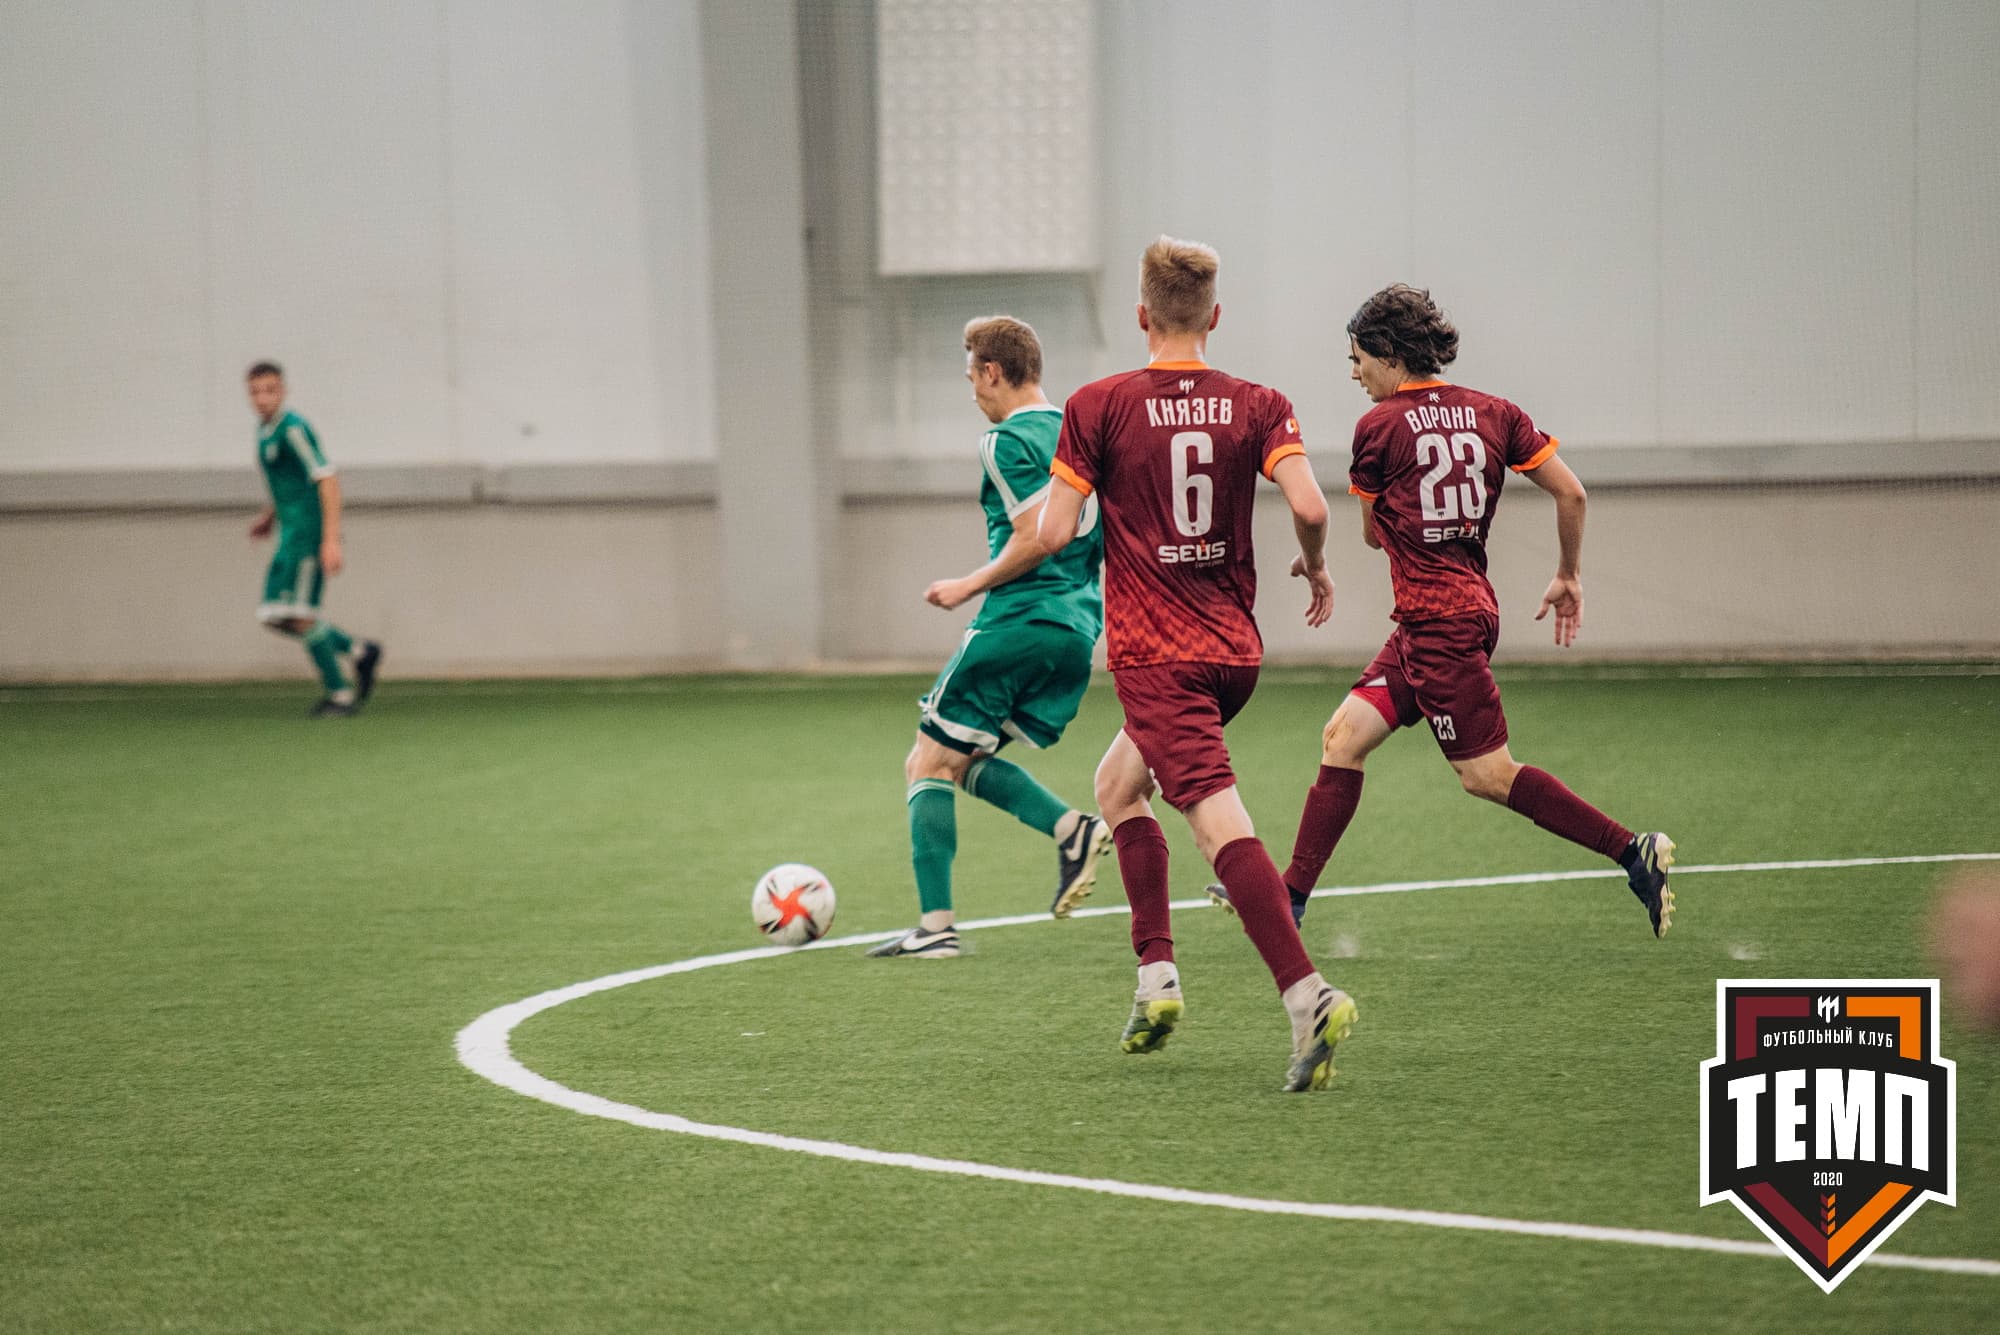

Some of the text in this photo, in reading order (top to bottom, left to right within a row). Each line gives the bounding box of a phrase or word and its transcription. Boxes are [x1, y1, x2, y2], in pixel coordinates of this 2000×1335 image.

[1145, 398, 1233, 427] КНЯЗЕВ
[1404, 405, 1478, 434] ВОРОНА
[1170, 431, 1214, 537] 6
[1416, 432, 1488, 521] 23
[1158, 541, 1227, 564] SEUS
[1433, 715, 1456, 740] 23
